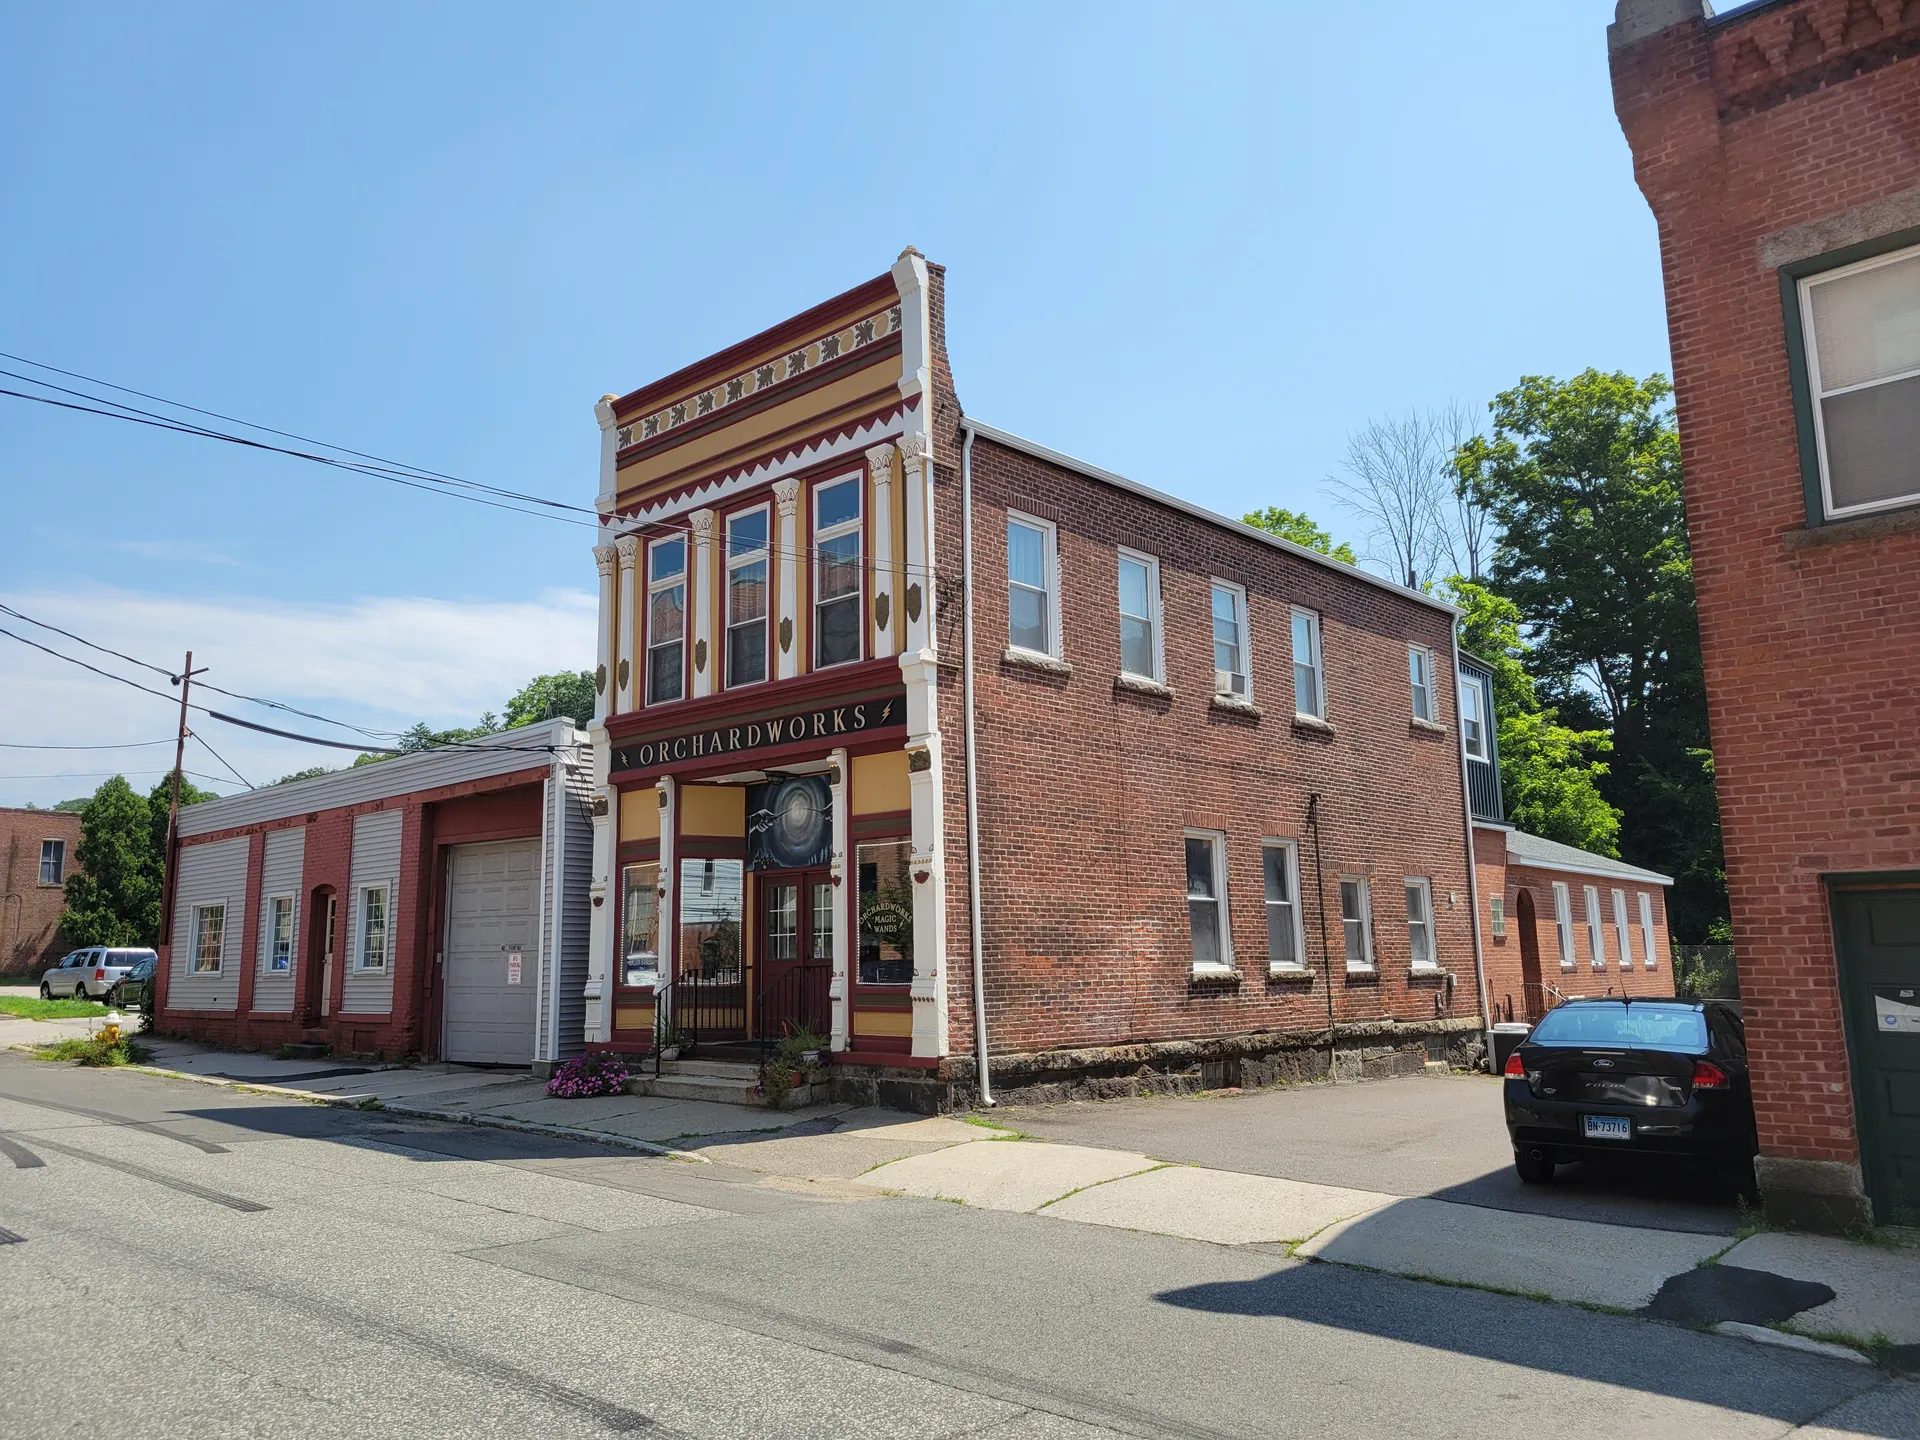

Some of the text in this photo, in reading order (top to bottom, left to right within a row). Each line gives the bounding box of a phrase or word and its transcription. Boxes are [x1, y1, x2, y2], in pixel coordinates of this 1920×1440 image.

[640, 705, 867, 765] ORCHARDWORKS
[860, 902, 913, 925] ORCHARDWORKS
[874, 915, 897, 924] MAGIC
[873, 925, 898, 933] WANDS
